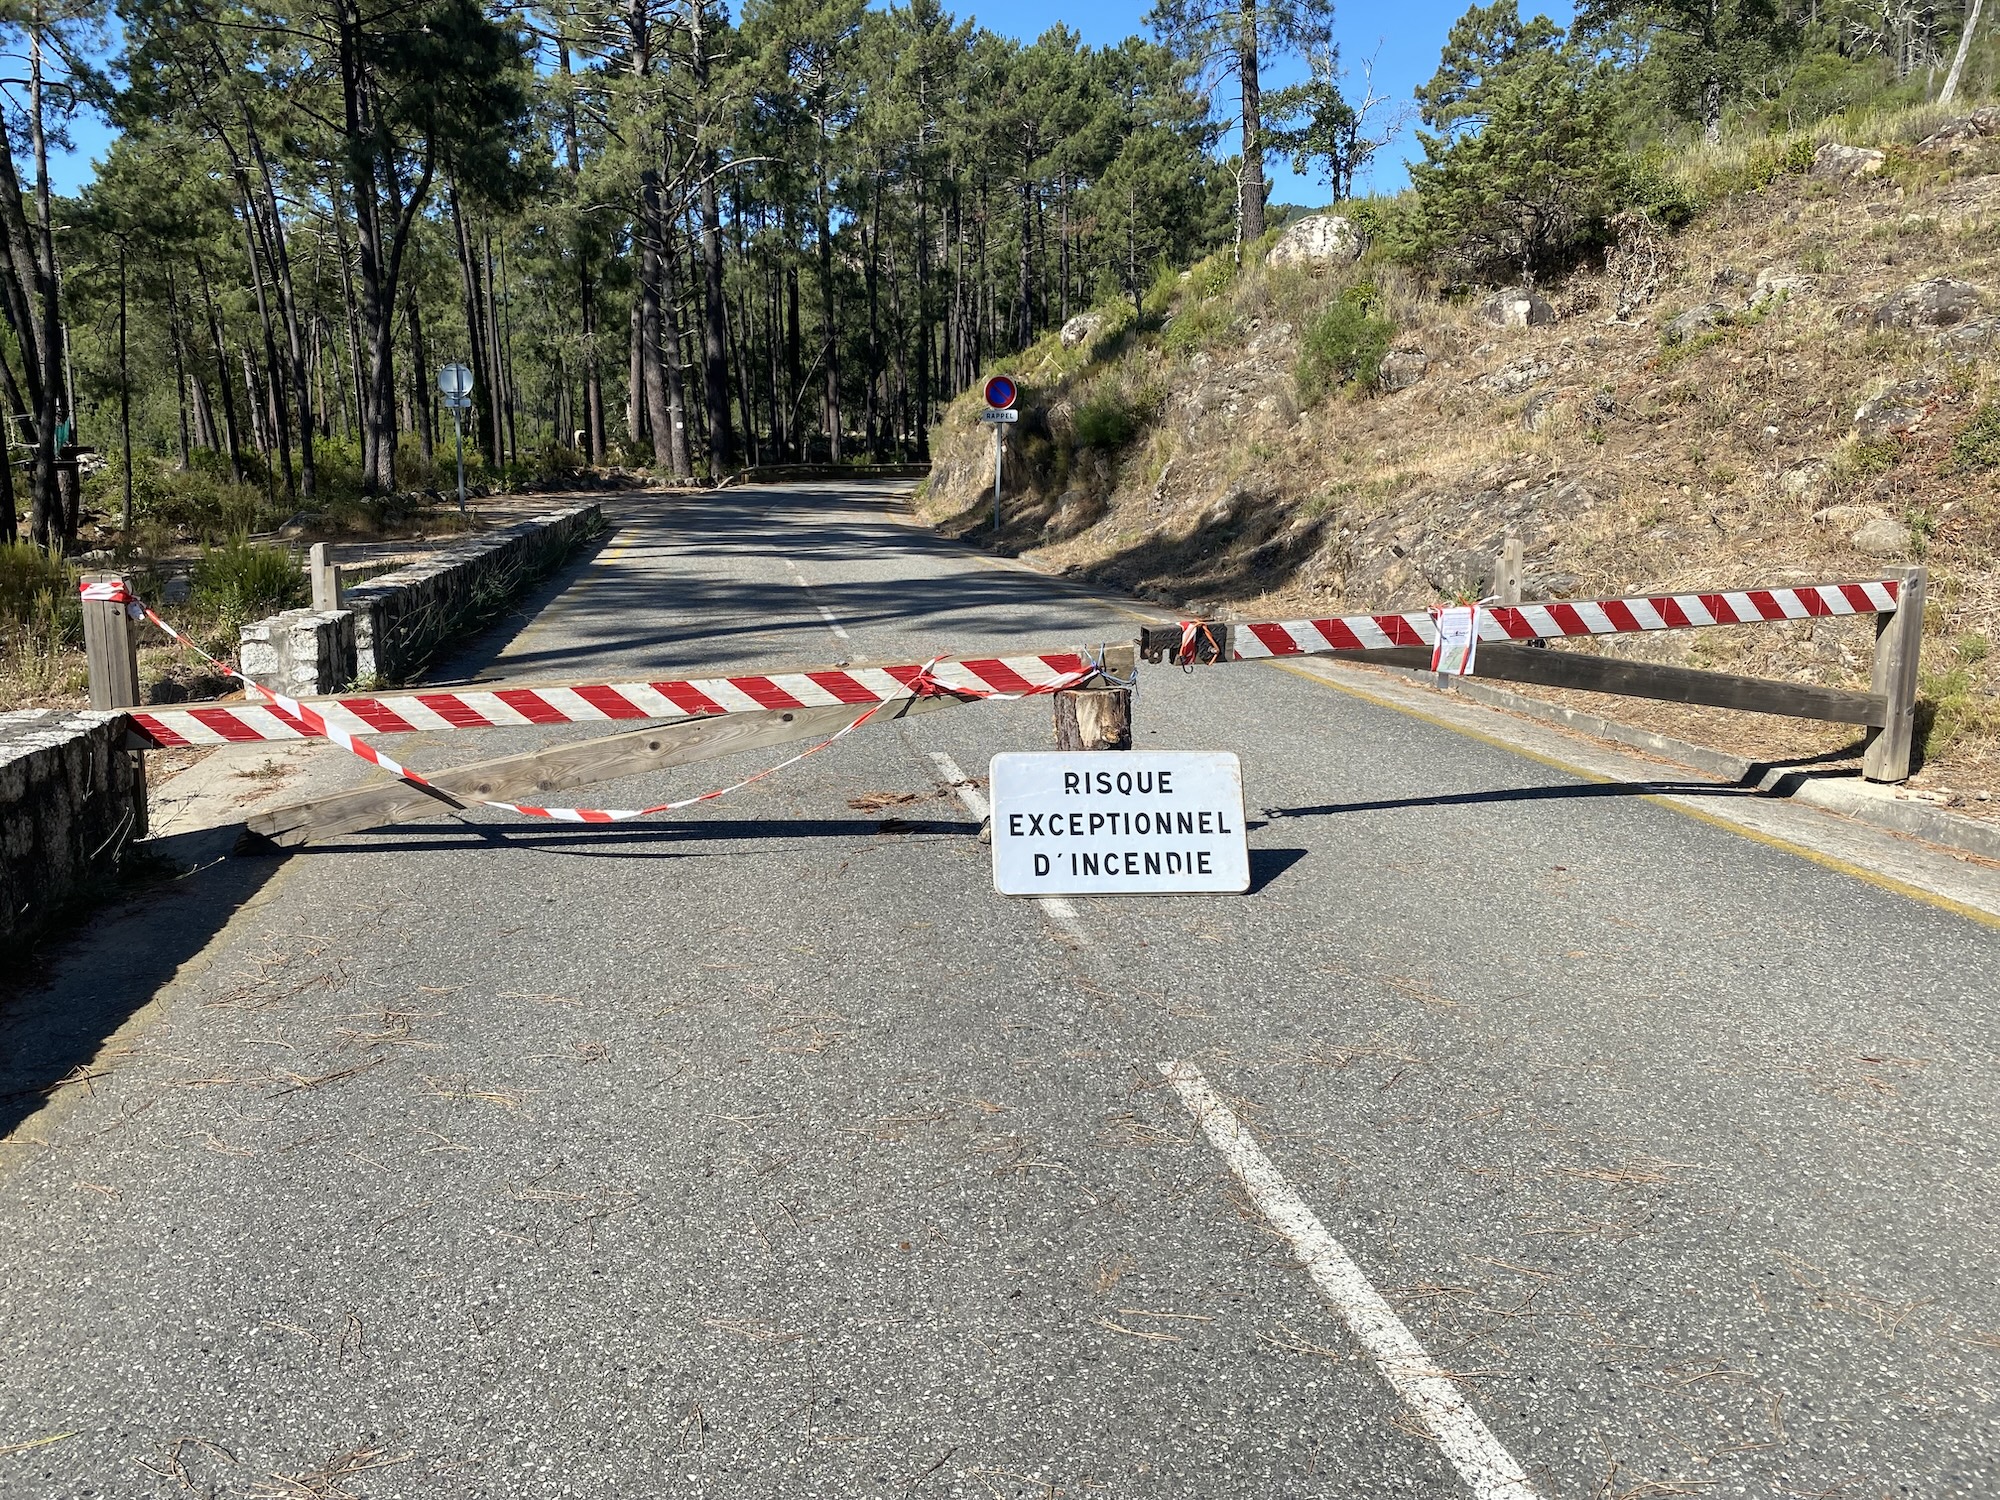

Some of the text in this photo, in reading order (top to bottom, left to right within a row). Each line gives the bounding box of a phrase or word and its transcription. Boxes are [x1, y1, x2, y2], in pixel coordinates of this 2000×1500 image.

[986, 412, 1014, 420] RAPPEL
[1064, 772, 1173, 796] RISQUE
[1009, 811, 1231, 836] EXCEPTIONNEL
